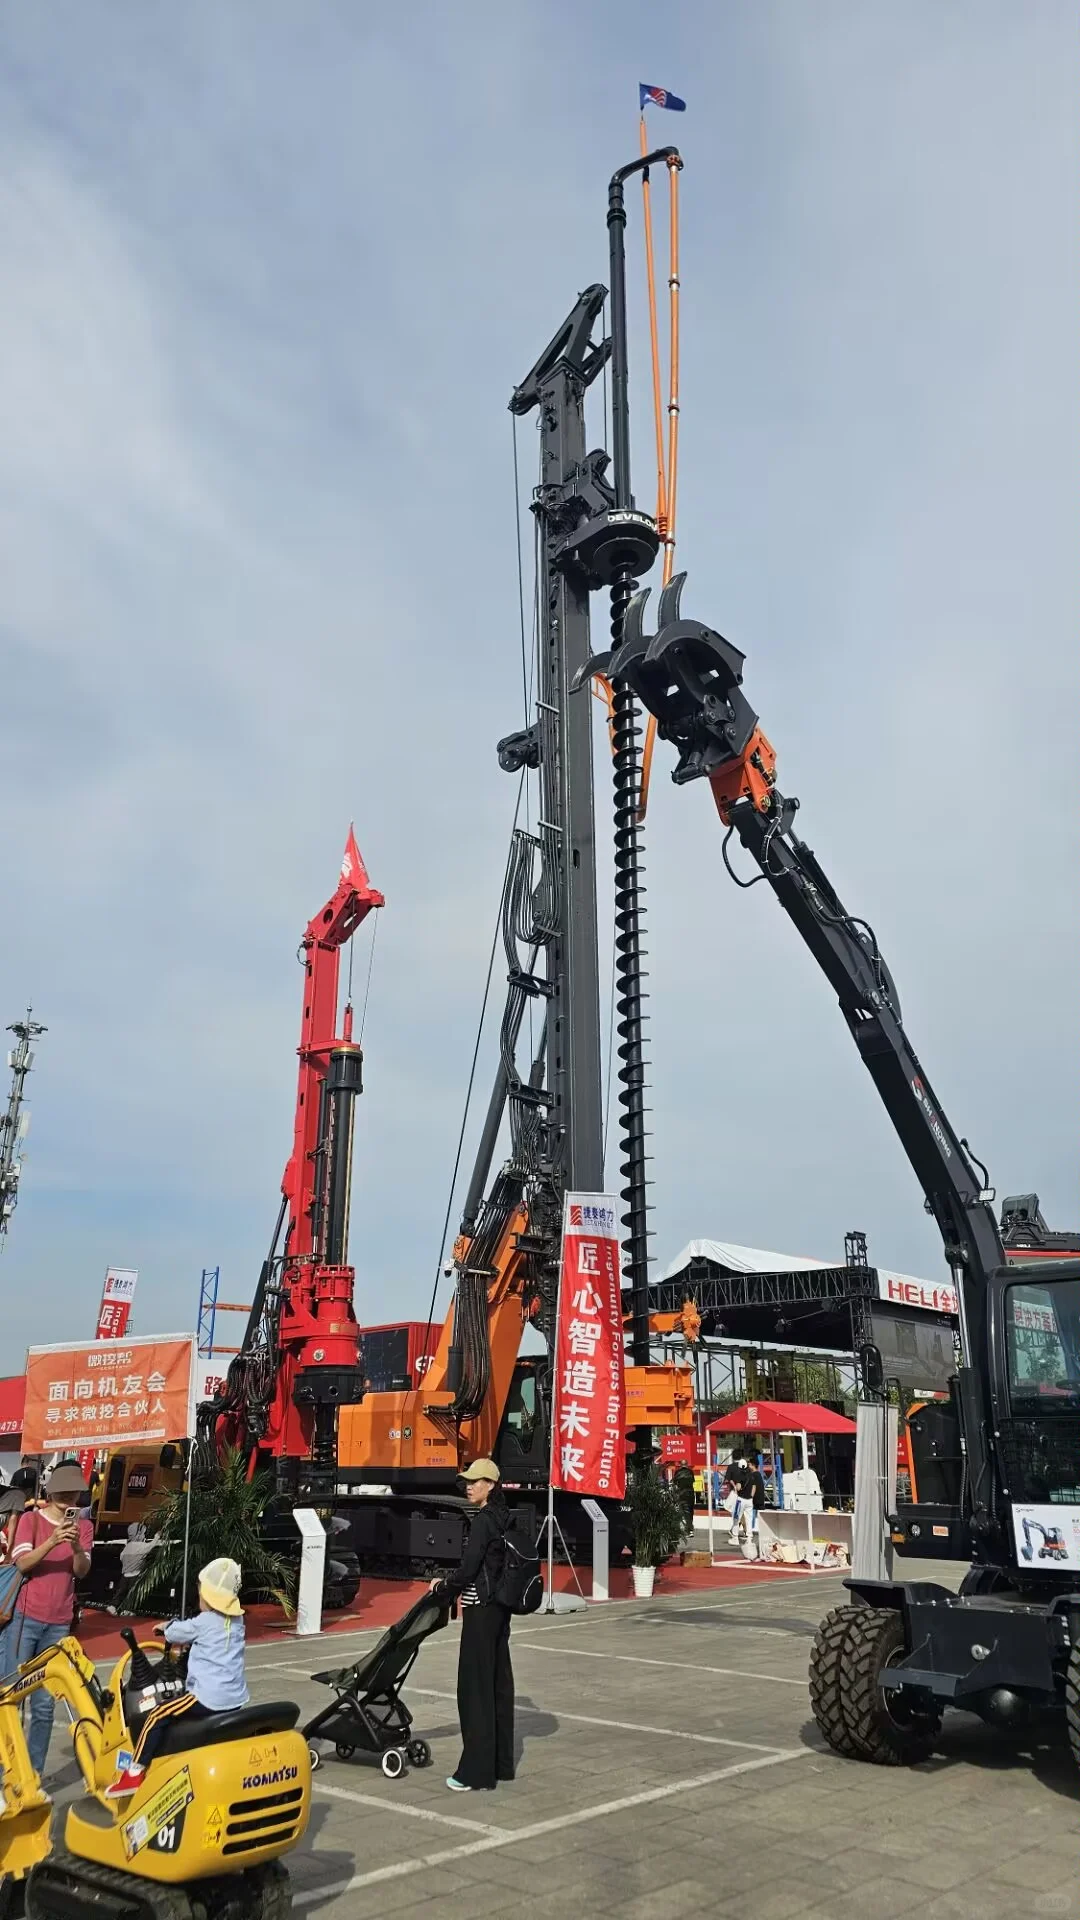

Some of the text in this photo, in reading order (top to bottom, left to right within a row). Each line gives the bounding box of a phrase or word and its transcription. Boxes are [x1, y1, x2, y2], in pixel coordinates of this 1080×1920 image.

[887, 1279, 939, 1308] HELI
[560, 1242, 603, 1482] 匠心智造未来
[598, 1245, 621, 1489] Ingenuity Forges the Future
[48, 1371, 166, 1402] 面向机友会
[45, 1398, 166, 1424] 寻求微挖合伙人
[242, 1764, 298, 1790] KOMATSU
[157, 1825, 176, 1849] 01
